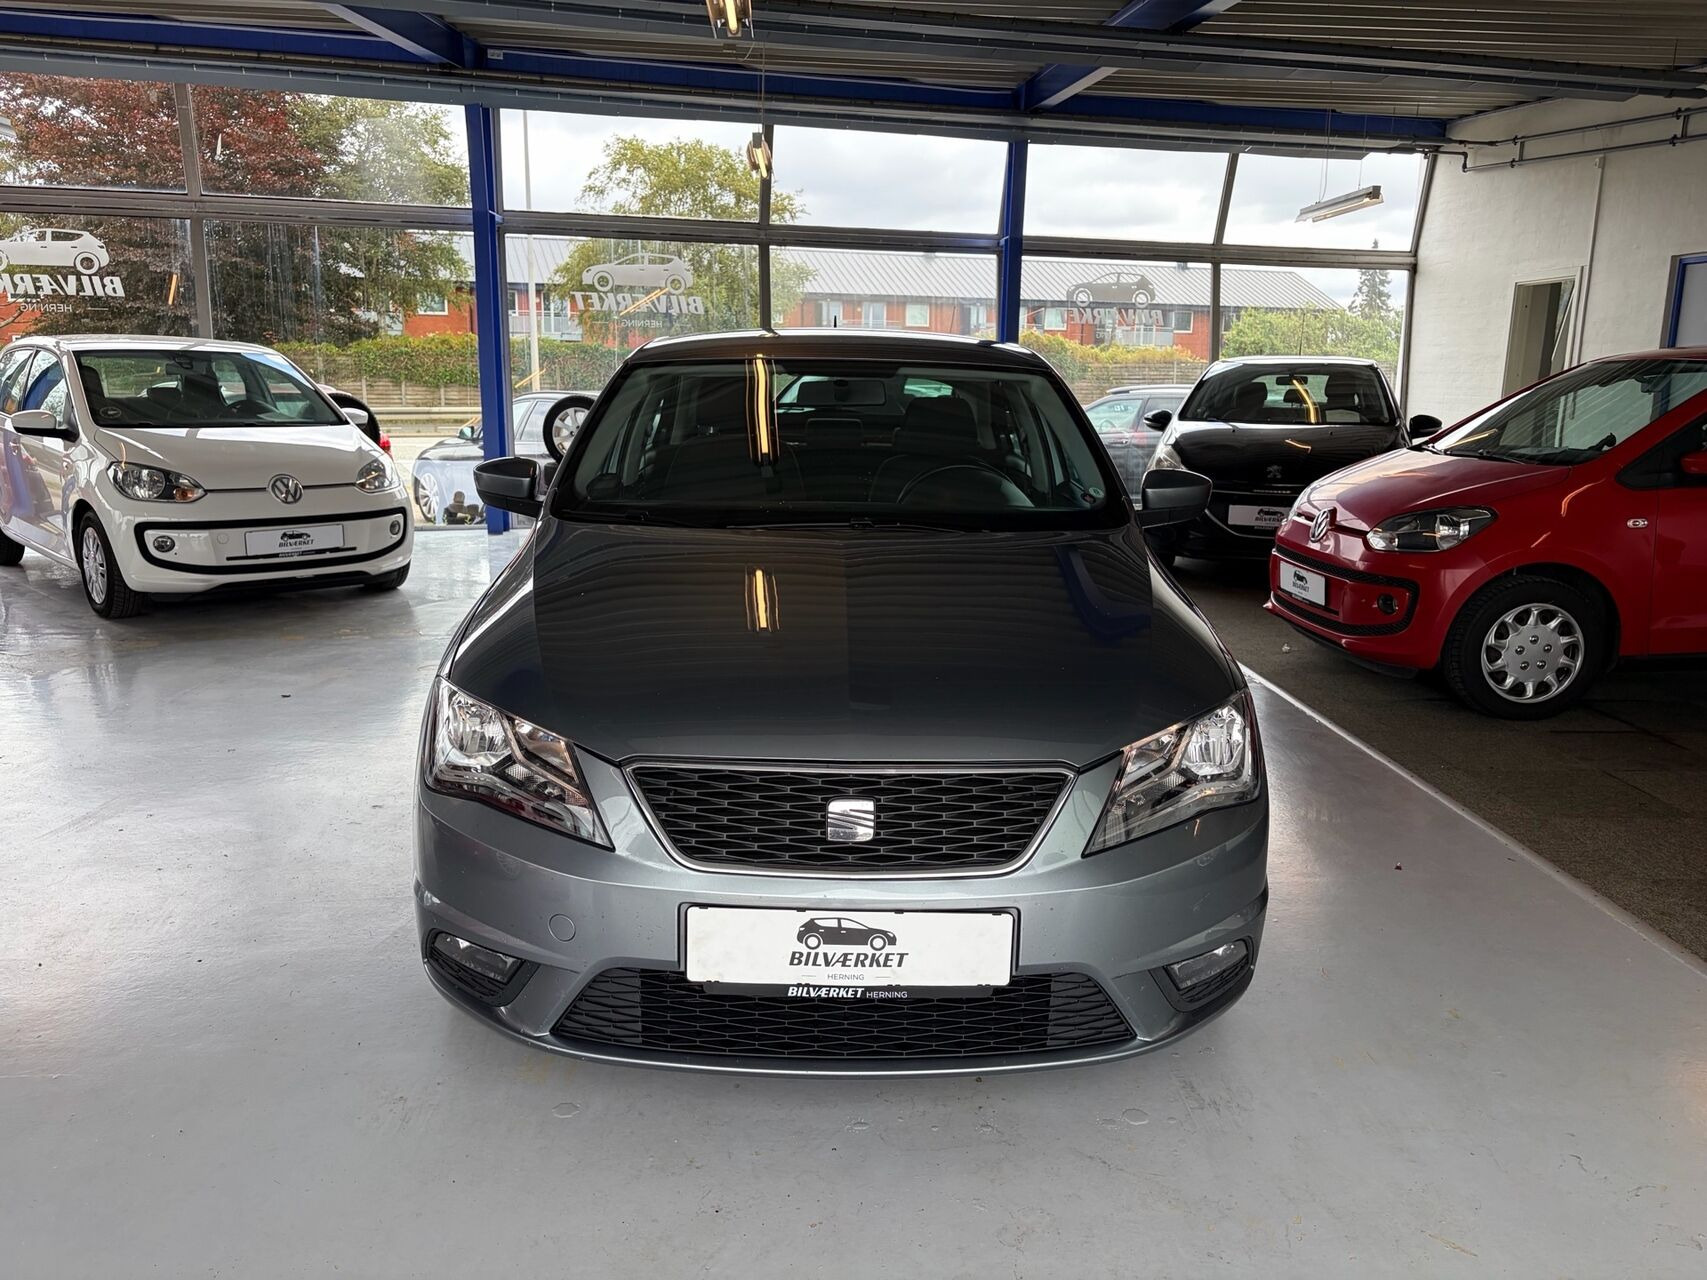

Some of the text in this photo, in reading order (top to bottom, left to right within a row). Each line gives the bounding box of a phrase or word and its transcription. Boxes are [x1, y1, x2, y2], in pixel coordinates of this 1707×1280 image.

[789, 951, 909, 968] BILVÆRKET
[827, 973, 865, 981] HERNING
[787, 986, 908, 999] BILVÆRKET HERNING
